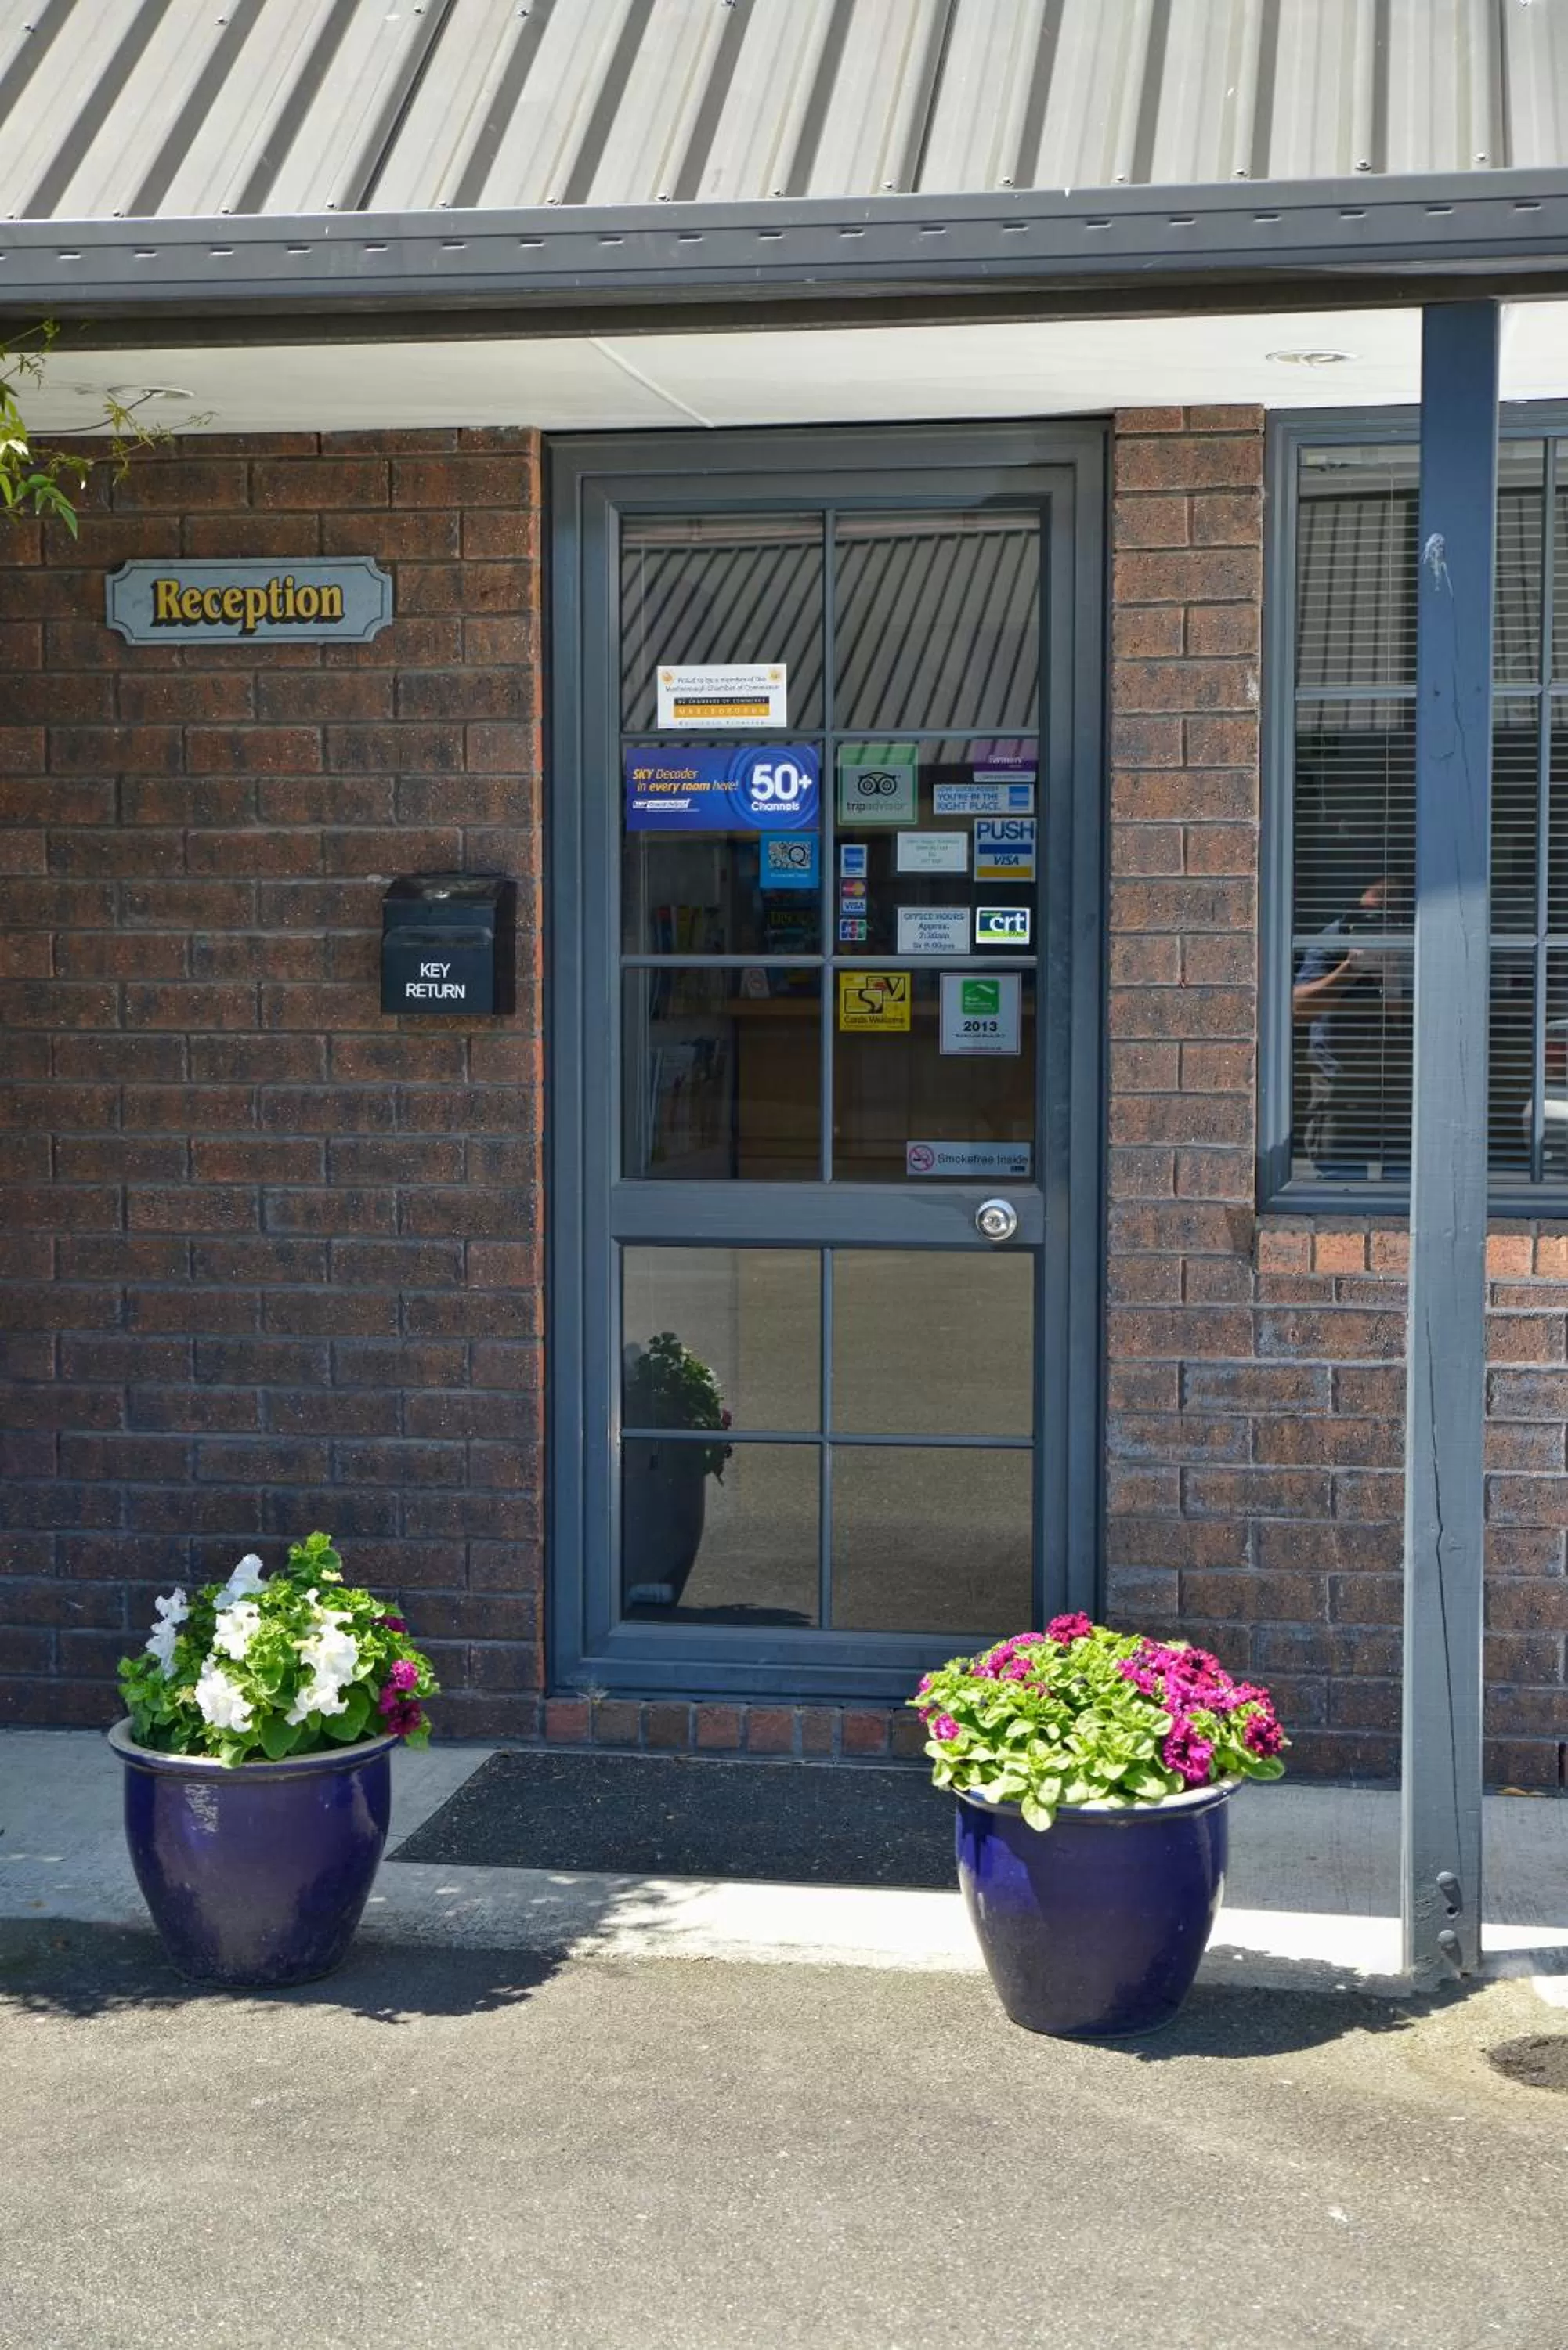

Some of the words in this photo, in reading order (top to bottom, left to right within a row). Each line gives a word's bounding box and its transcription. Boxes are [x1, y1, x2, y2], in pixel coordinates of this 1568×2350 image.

[151, 575, 345, 635] Reception
[656, 768, 698, 779] Decoder
[636, 781, 647, 792] in
[649, 783, 680, 794] every
[681, 783, 710, 791] room
[751, 763, 813, 801] 50+
[752, 801, 800, 812] Channels
[846, 800, 906, 813] tripadvisor
[937, 801, 966, 811] RIGHT
[977, 821, 1034, 841] PUSH
[992, 855, 1021, 866] VISA
[989, 912, 1025, 932] crt
[420, 963, 451, 978] KEY
[405, 982, 466, 999] RETURN
[963, 1021, 999, 1032] 2013
[937, 1152, 995, 1165] Smokefree
[997, 1152, 1029, 1165] Inside
